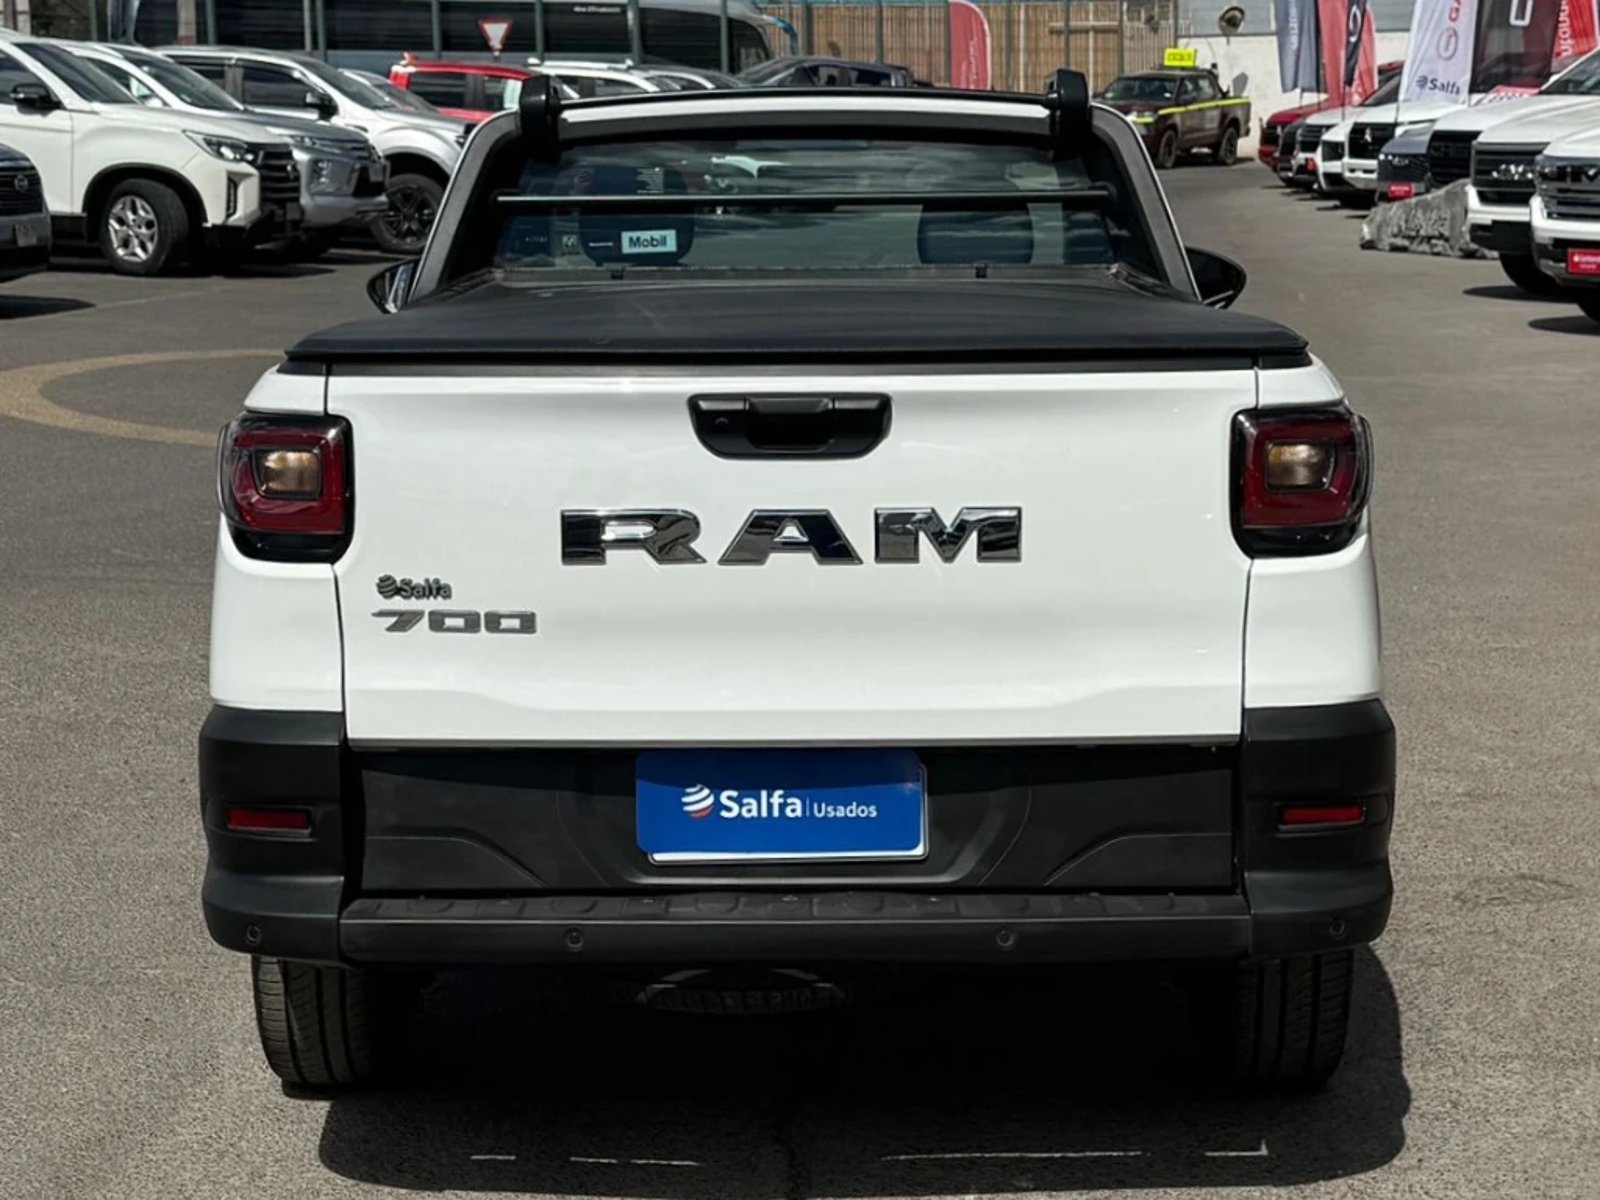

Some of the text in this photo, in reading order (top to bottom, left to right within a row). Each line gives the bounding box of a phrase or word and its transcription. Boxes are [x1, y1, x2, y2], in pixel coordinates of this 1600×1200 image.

[628, 234, 667, 249] Mobil
[559, 506, 1023, 566] RAM
[400, 577, 453, 600] Salfa
[371, 608, 537, 635] 700
[719, 789, 878, 818] Salfa Usados
